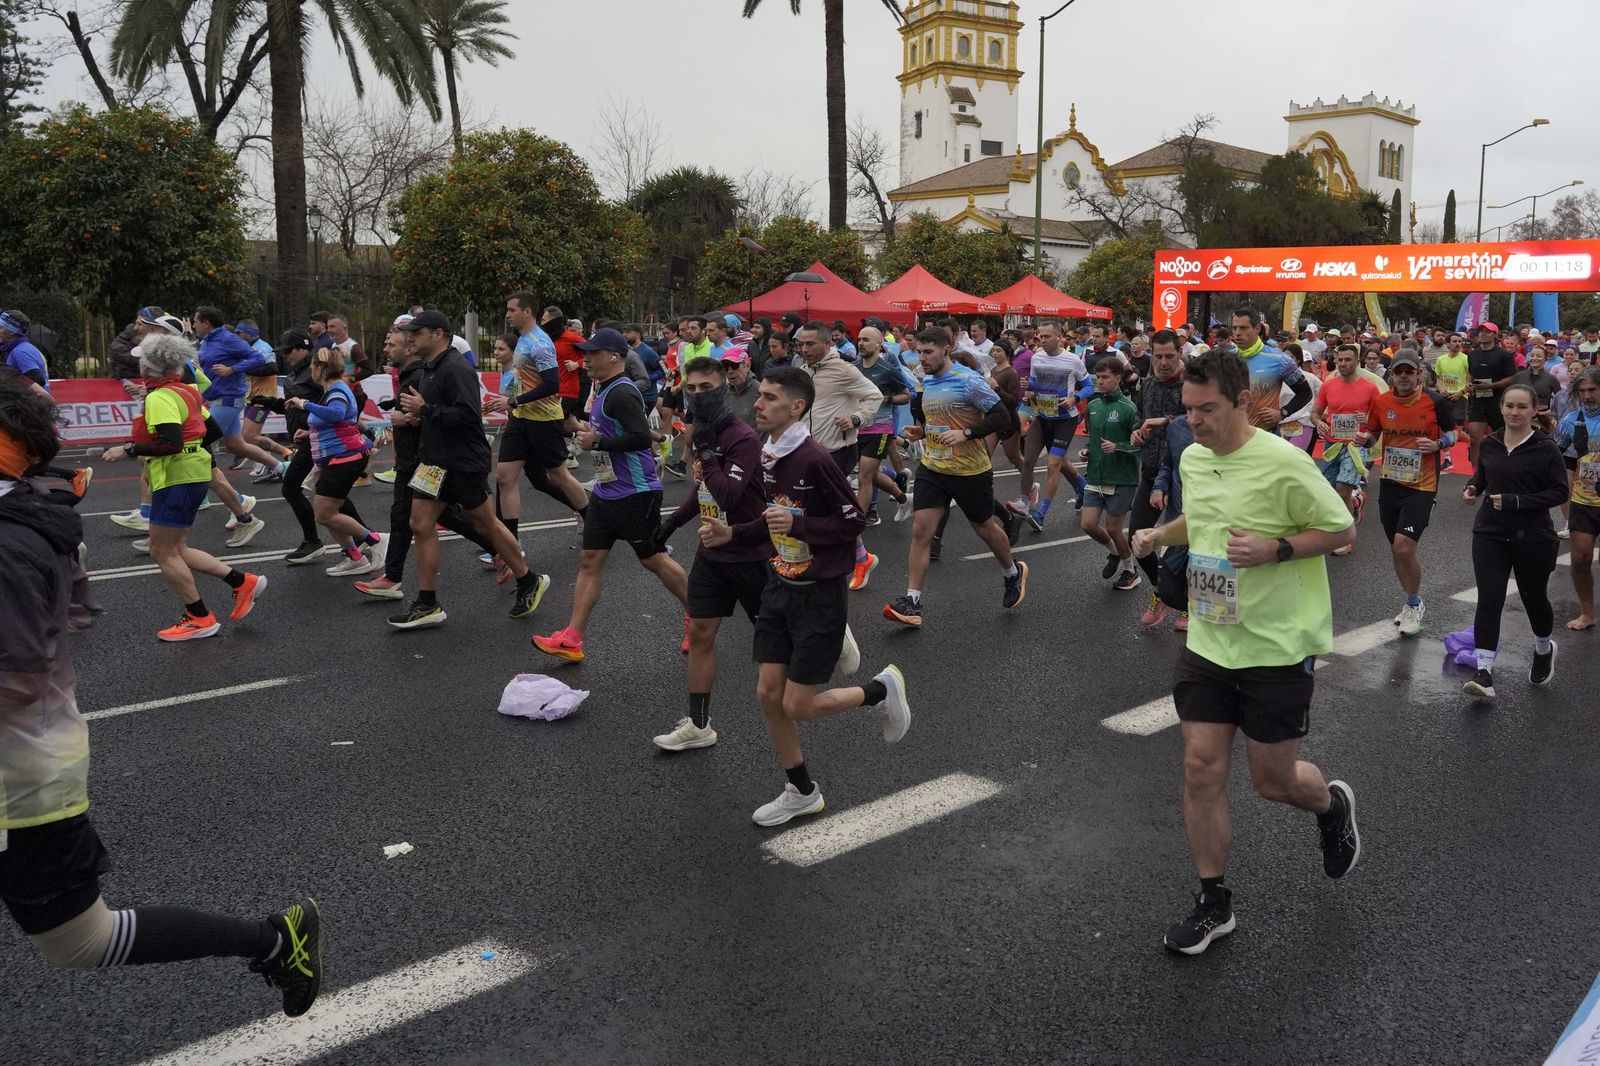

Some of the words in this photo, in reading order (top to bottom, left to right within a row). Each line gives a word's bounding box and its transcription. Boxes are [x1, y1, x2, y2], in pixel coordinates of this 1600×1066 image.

[1430, 252, 1502, 267] maratón
[1235, 265, 1272, 275] Sprinter
[1313, 261, 1358, 277] HOKA
[1444, 264, 1502, 280] sevilla
[1519, 260, 1584, 273] 00:11:18
[53, 403, 145, 426] CREAT
[1333, 420, 1356, 429] 19432
[1387, 455, 1414, 468] 19264
[728, 472, 743, 481] Jeep
[843, 511, 858, 520] Jeep
[1187, 567, 1227, 595] 21342
